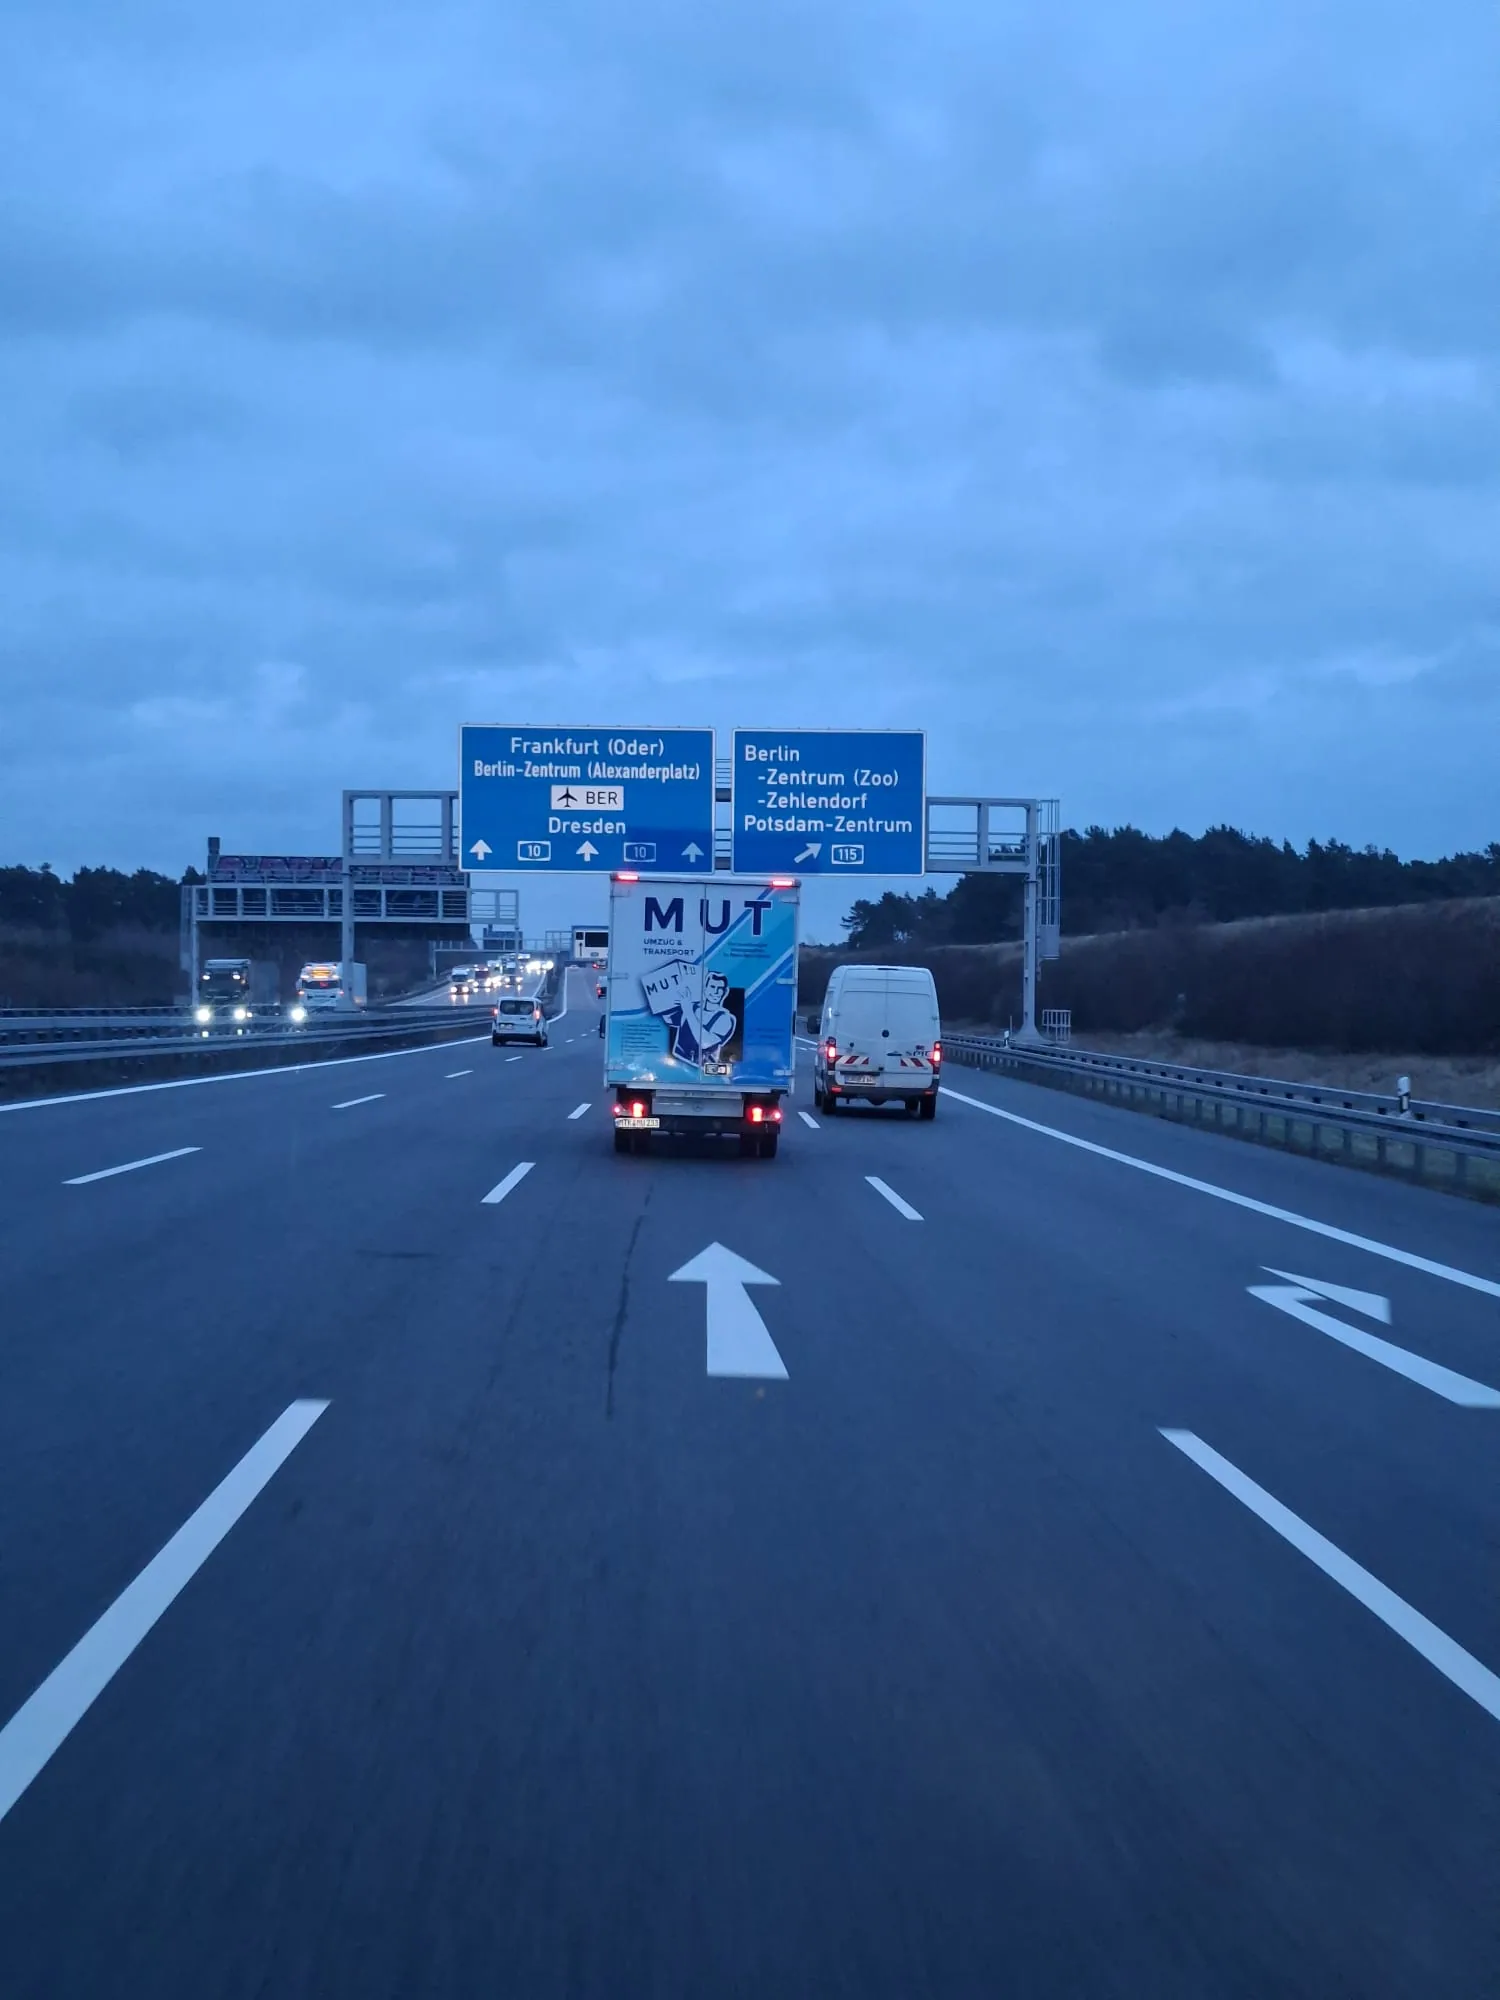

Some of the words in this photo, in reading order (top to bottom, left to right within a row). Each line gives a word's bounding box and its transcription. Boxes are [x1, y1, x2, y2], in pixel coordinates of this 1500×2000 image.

[510, 737, 599, 755] Frankfurt
[608, 738, 664, 756] (Oder)
[745, 744, 800, 761] Berlin
[474, 760, 581, 778] Berlin-Zentrum
[587, 762, 700, 783] (Alexanderplatz)
[758, 768, 845, 785] -Zentrum
[854, 768, 899, 787] (Zoo)
[586, 791, 618, 804] BER
[758, 792, 868, 809] -Zehlendorf
[549, 817, 626, 834] Dresden
[744, 815, 912, 833] Potsdam-Zentrum
[527, 845, 541, 857] 10
[634, 846, 647, 858] 10
[839, 848, 857, 861] 115
[644, 897, 772, 936] MUT
[643, 938, 675, 946] UMZUG
[643, 948, 695, 956] TRANSPORT
[646, 974, 680, 996] MUT
